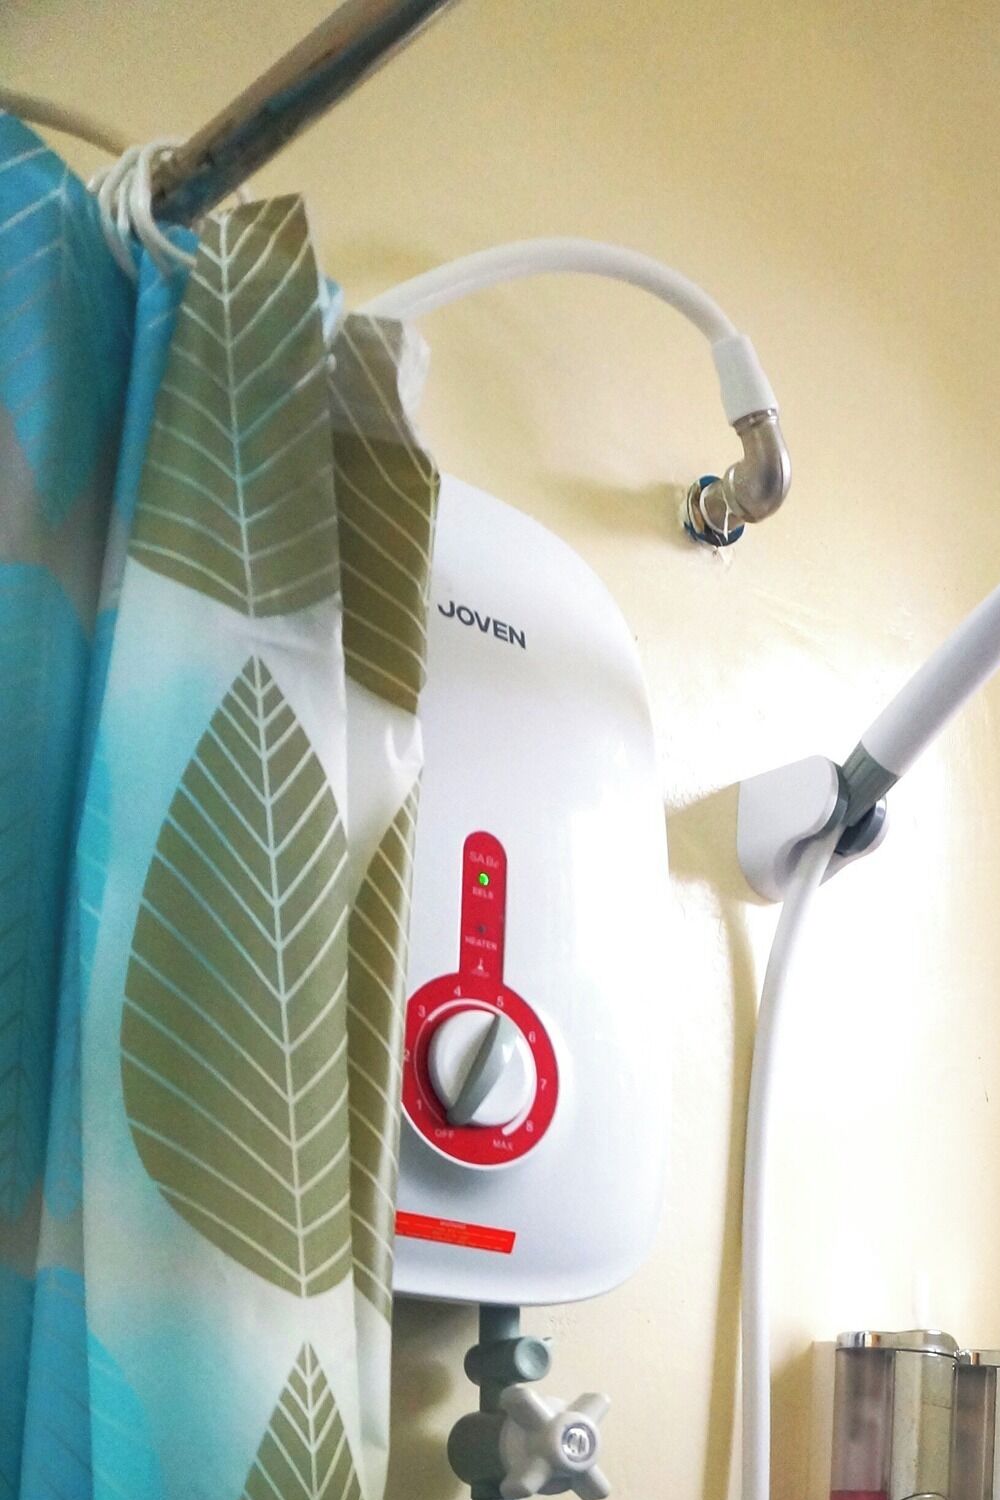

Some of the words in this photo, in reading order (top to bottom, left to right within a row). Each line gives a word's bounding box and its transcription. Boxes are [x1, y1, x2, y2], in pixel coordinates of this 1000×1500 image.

[438, 601, 526, 649] JOVEN
[454, 985, 461, 997] 4
[496, 996, 504, 1008] 5
[418, 1004, 426, 1018] 3
[528, 1030, 536, 1043] 6
[540, 1078, 548, 1091] 7
[525, 1120, 534, 1133] 8
[492, 1138, 513, 1151] MAX
